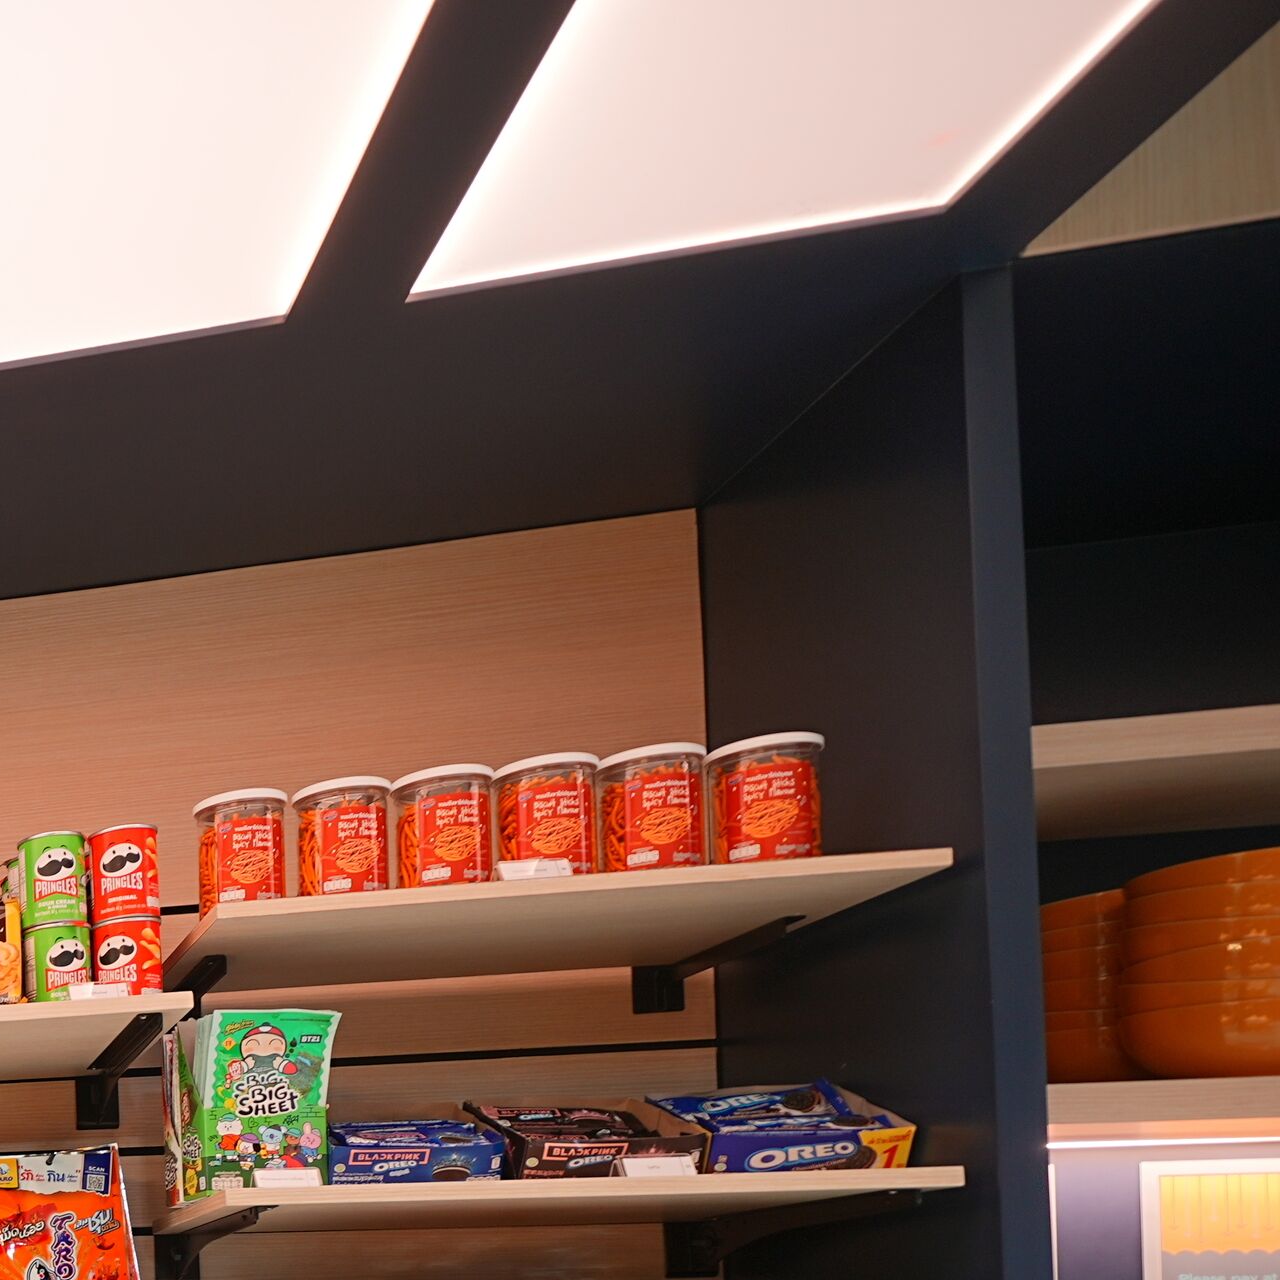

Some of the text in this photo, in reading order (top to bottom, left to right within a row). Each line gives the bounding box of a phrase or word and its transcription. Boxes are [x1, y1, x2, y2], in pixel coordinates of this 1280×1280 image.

[35, 877, 77, 899] PRINGLES
[101, 871, 143, 896] PRINGLES
[47, 969, 87, 989] PRINGLES
[251, 1085, 289, 1103] BIG
[373, 1160, 417, 1172] OREO
[749, 1141, 855, 1170] OREO
[52, 1212, 76, 1280] TARO
